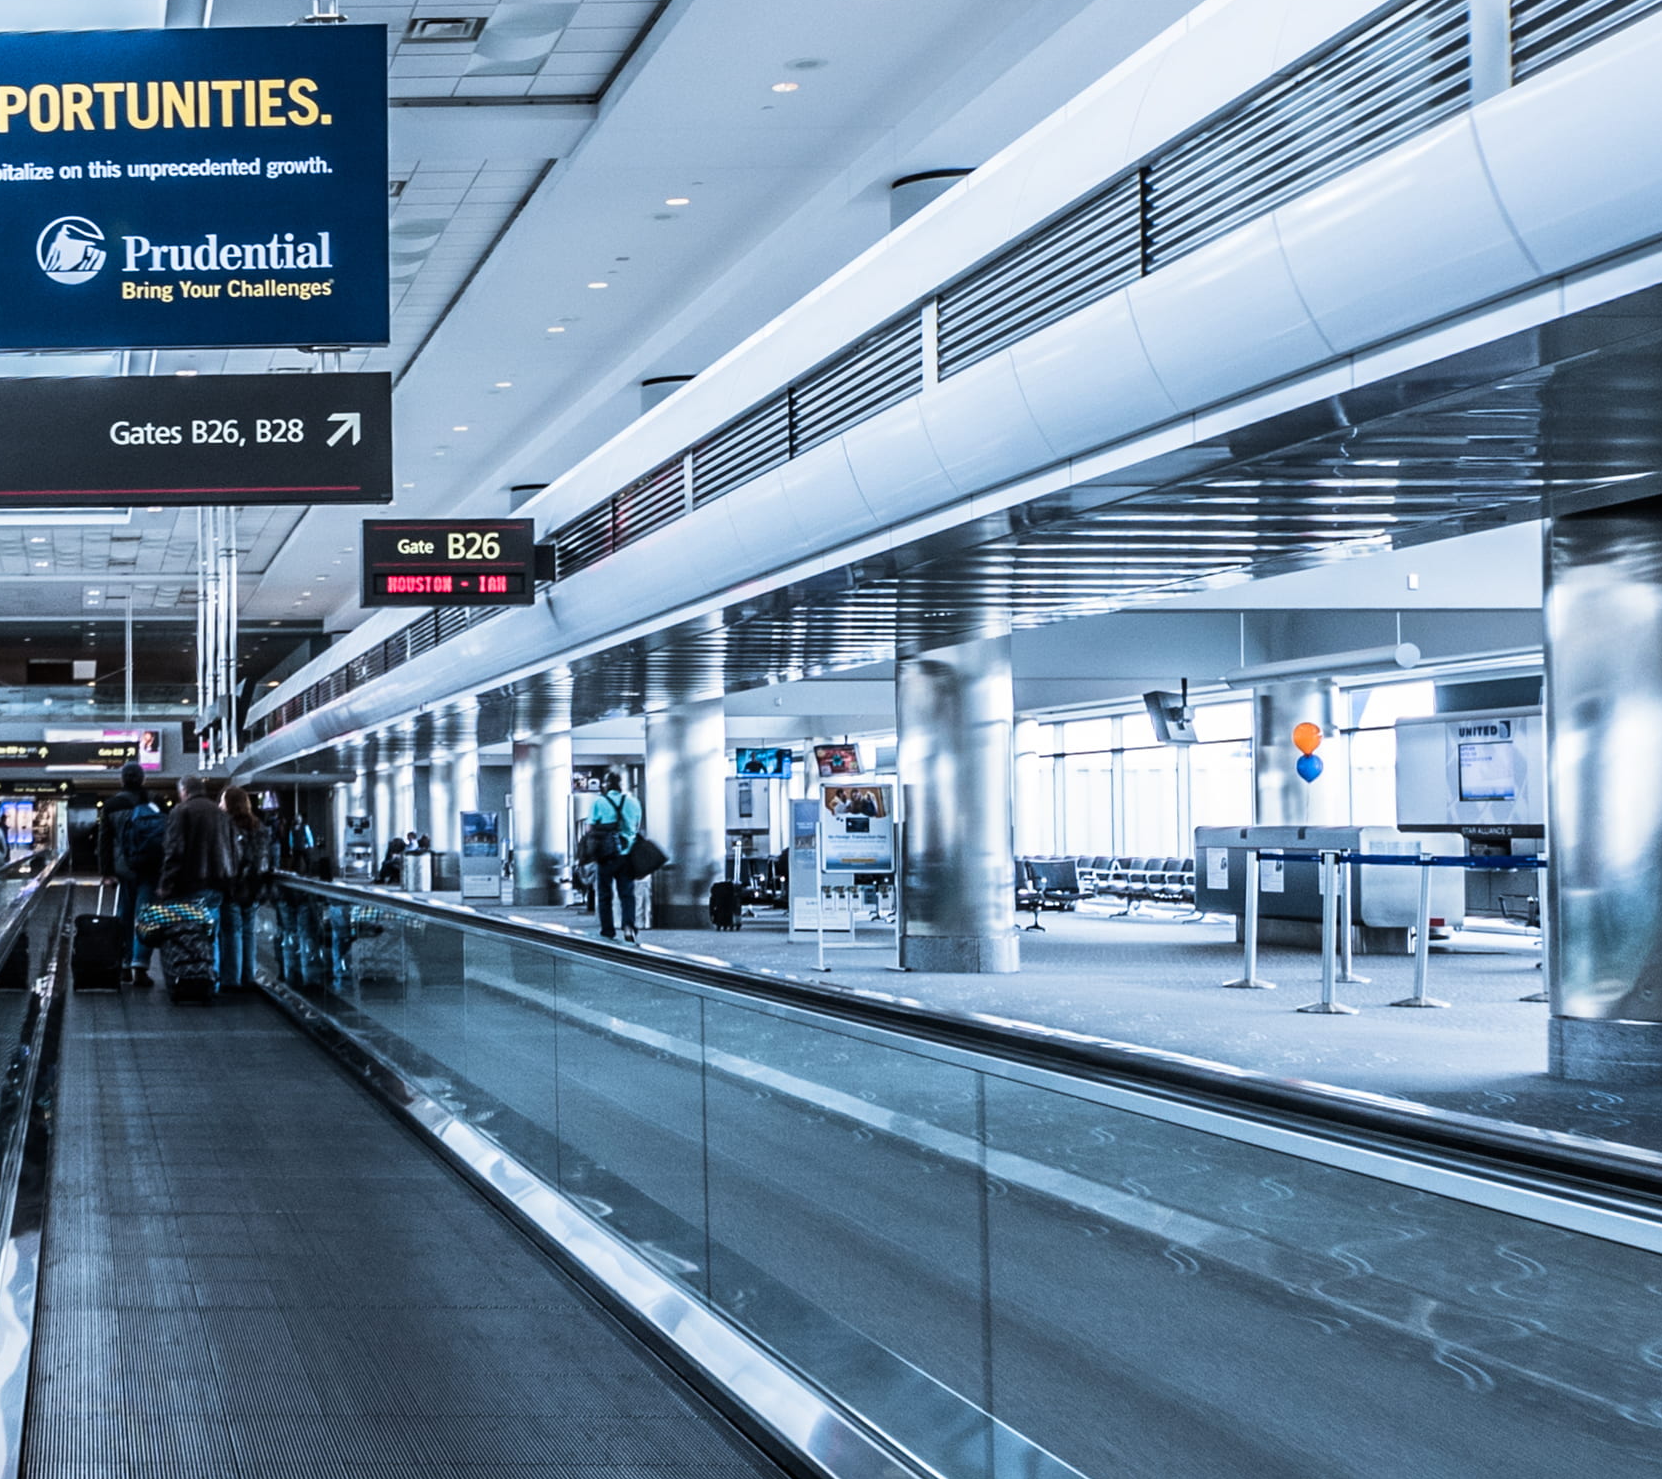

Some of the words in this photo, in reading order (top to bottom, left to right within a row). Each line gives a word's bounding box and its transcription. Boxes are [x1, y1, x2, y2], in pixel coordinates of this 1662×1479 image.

[59, 164, 82, 180] on
[88, 160, 122, 179] this
[127, 157, 261, 181] unprecedented
[266, 155, 333, 178] growth.
[121, 231, 333, 272] Prudential
[122, 281, 174, 302] Bring
[179, 280, 221, 298] Your
[227, 278, 332, 299] Challenges
[110, 421, 182, 445] Gates
[192, 419, 246, 447] B26,
[256, 419, 304, 443] B28
[397, 539, 434, 554] Gate
[447, 532, 501, 559] B26
[387, 576, 452, 593] HOUSTON
[1459, 725, 1497, 737] UNITED
